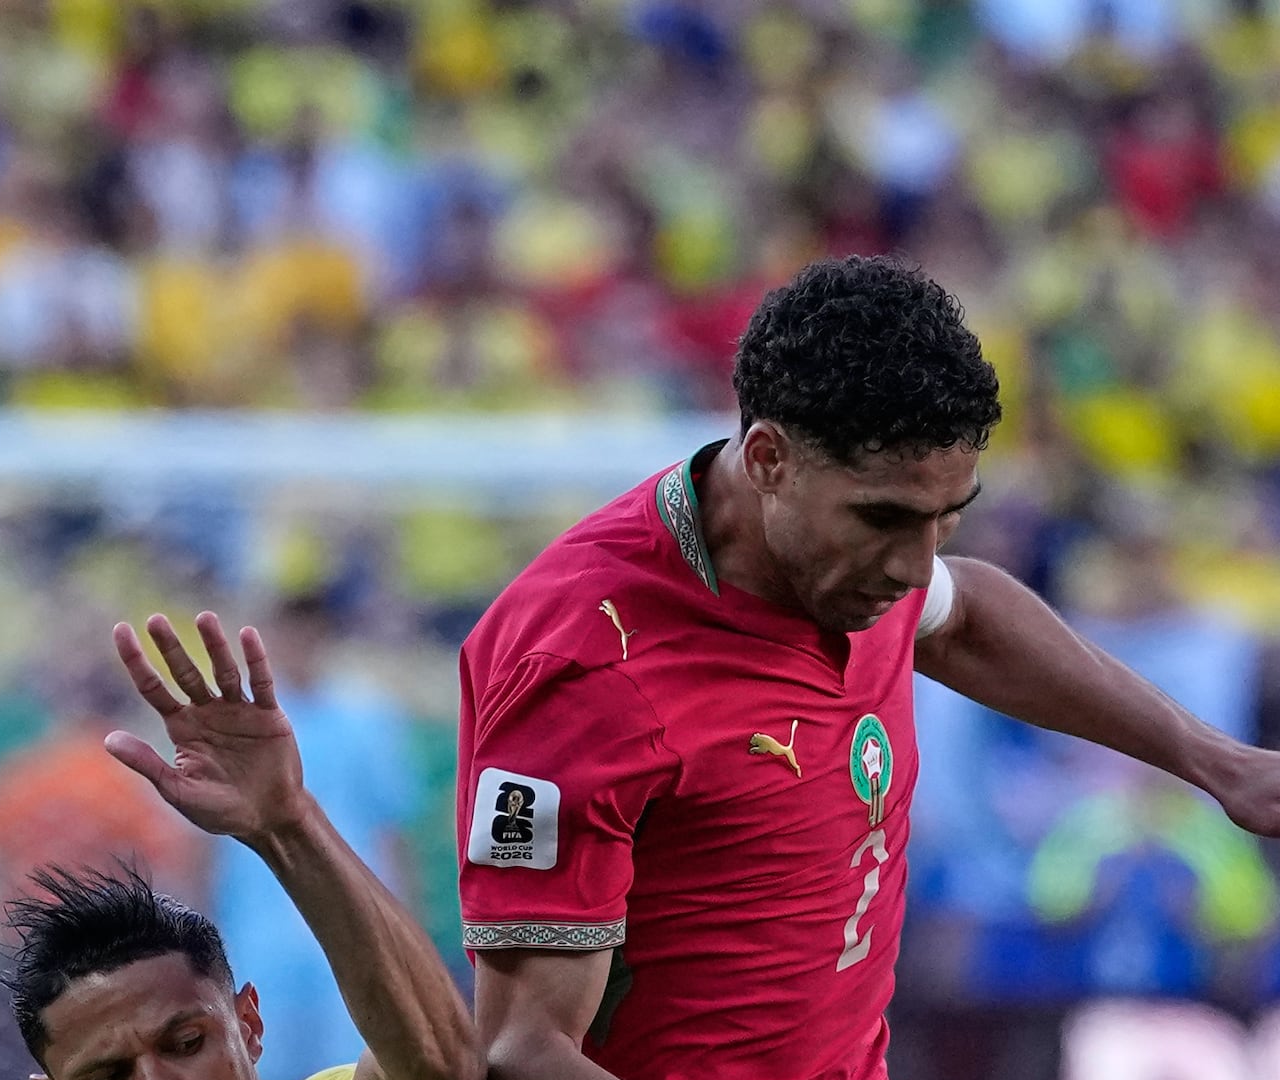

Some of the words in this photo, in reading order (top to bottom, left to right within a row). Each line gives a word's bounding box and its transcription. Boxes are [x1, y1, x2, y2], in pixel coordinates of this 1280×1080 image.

[502, 831, 522, 840] FIFA
[490, 851, 533, 860] 2026
[836, 829, 890, 972] 2
